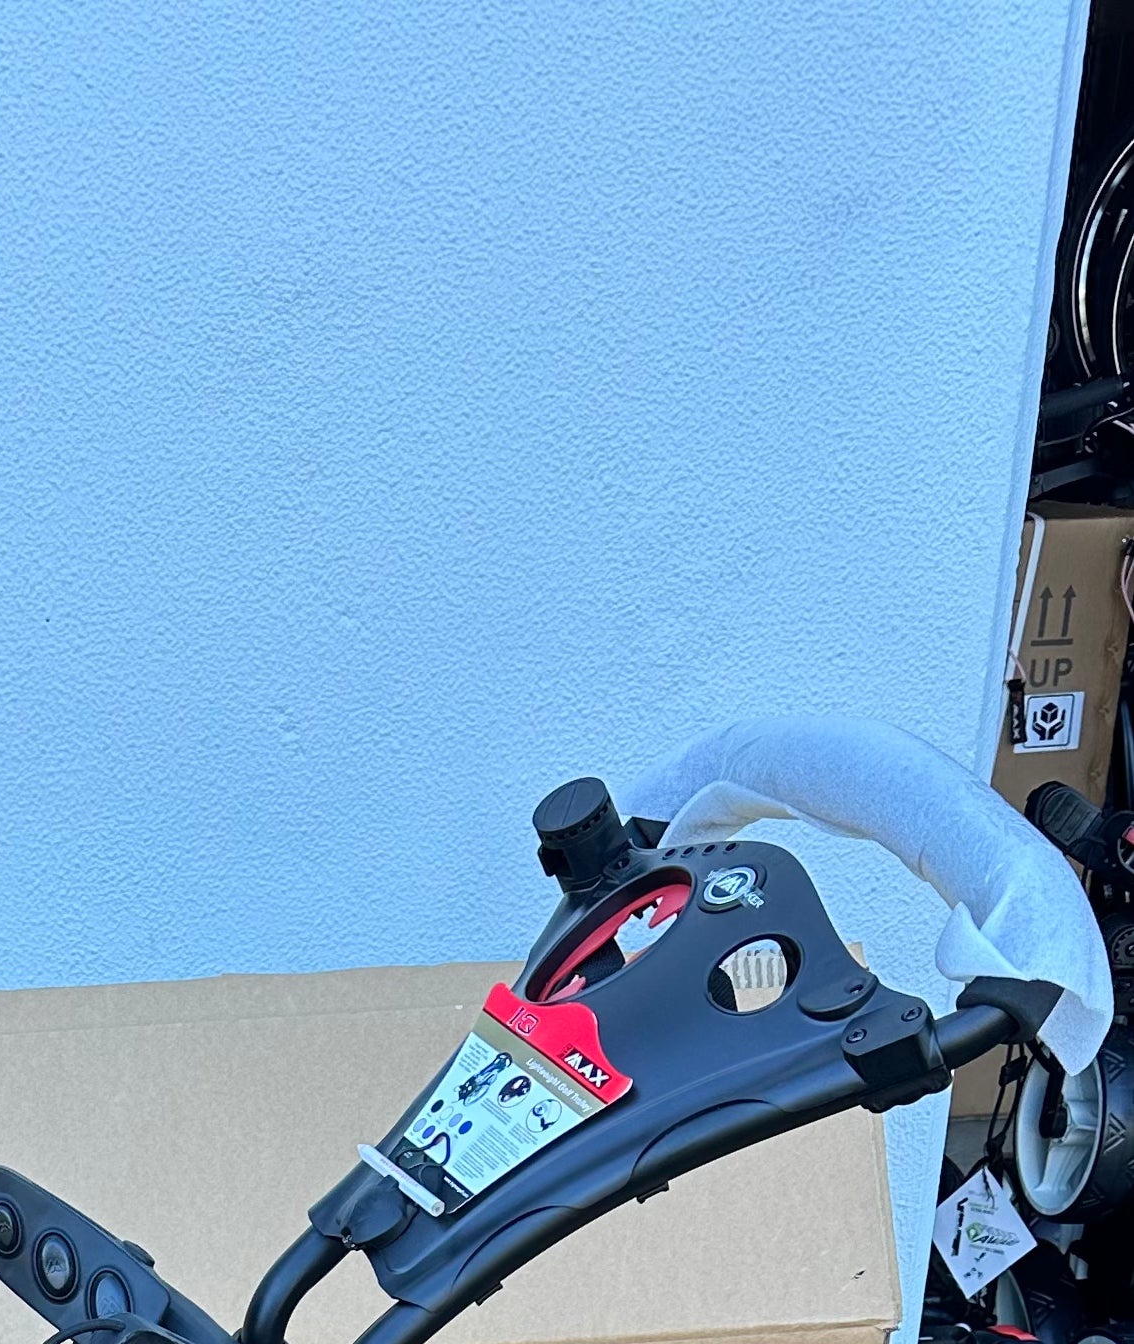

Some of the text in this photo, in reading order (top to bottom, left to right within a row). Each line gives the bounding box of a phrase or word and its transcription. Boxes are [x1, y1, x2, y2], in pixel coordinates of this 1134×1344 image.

[1029, 658, 1073, 687] UP
[525, 1057, 593, 1113] Lightweight Golf Trolley
[564, 1052, 610, 1088] MAX
